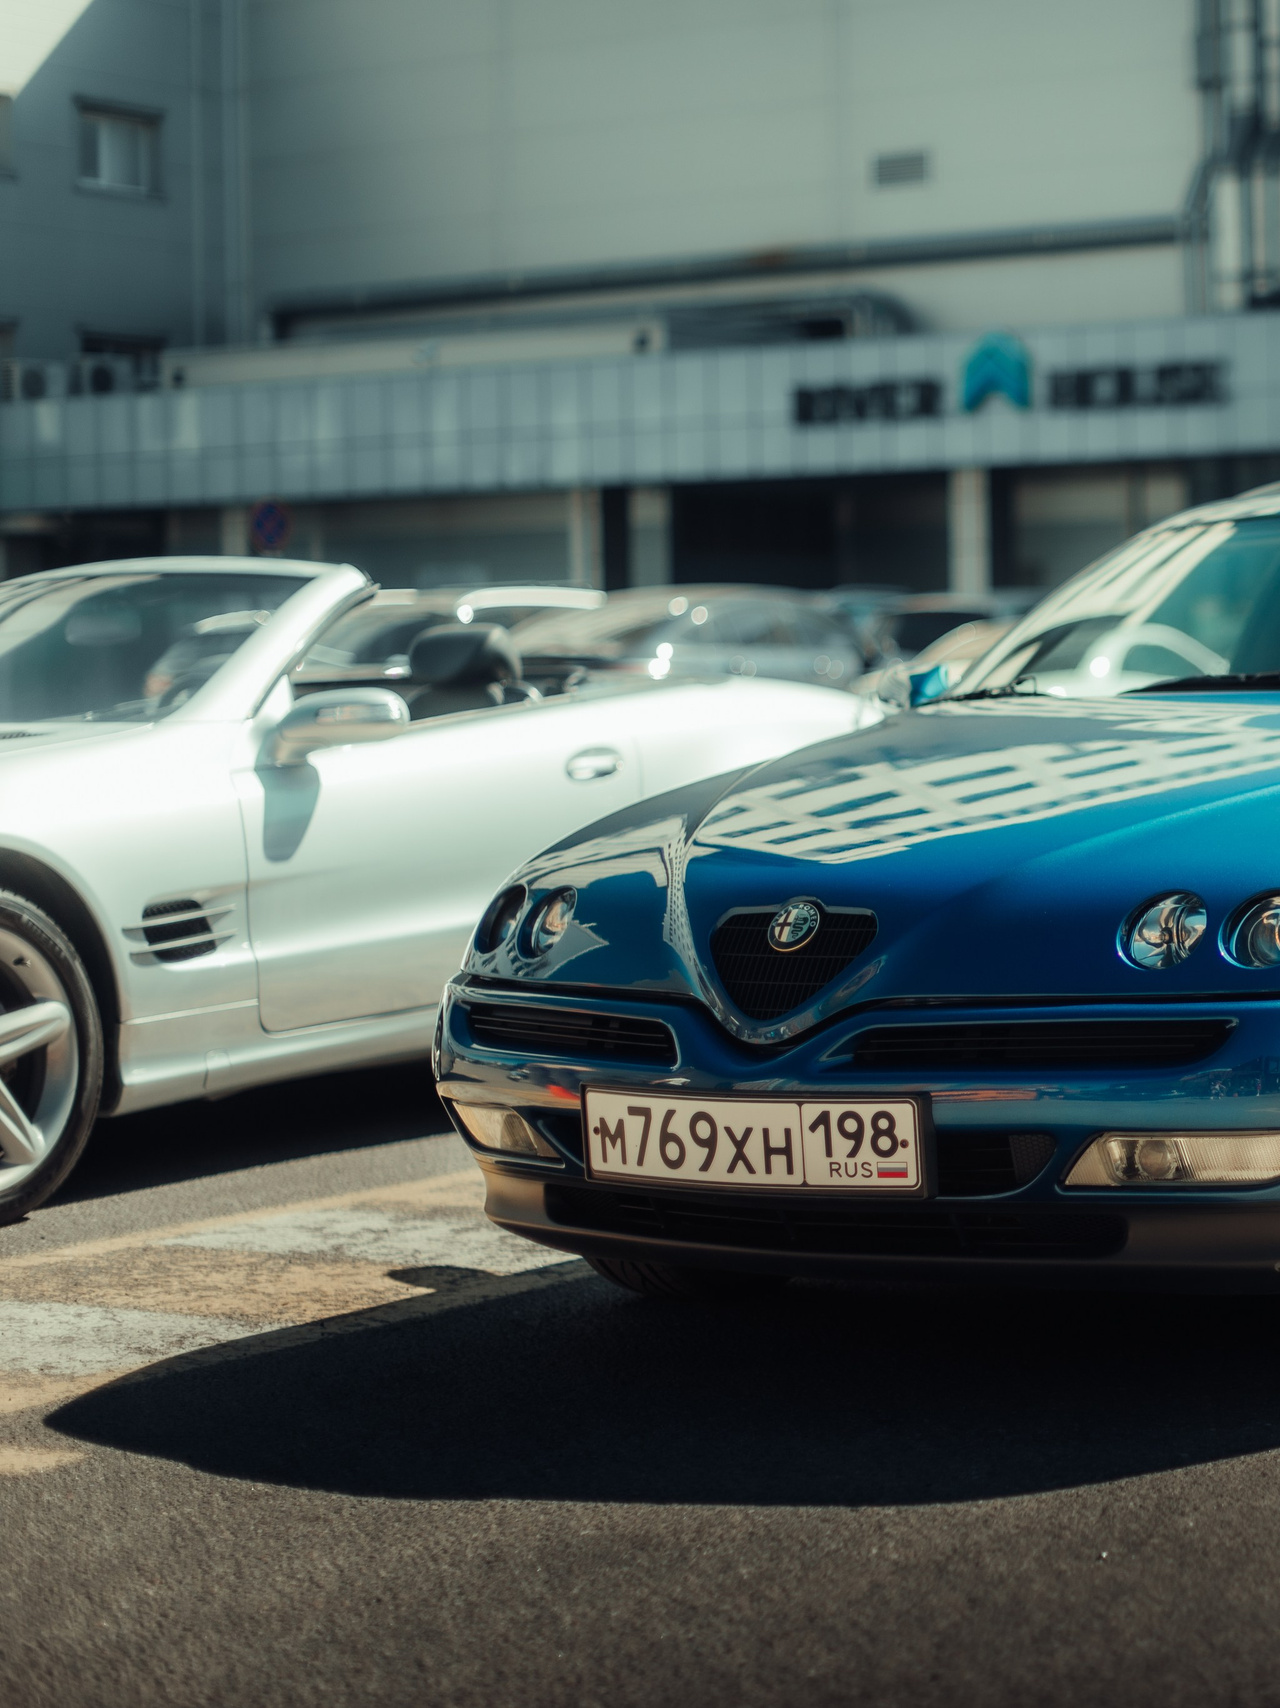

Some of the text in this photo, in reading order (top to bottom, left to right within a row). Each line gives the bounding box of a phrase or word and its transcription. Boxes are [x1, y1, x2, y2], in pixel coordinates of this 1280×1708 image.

[798, 904, 818, 928] ROMEO
[808, 1110, 899, 1159] 198
[829, 1161, 874, 1179] RUS
